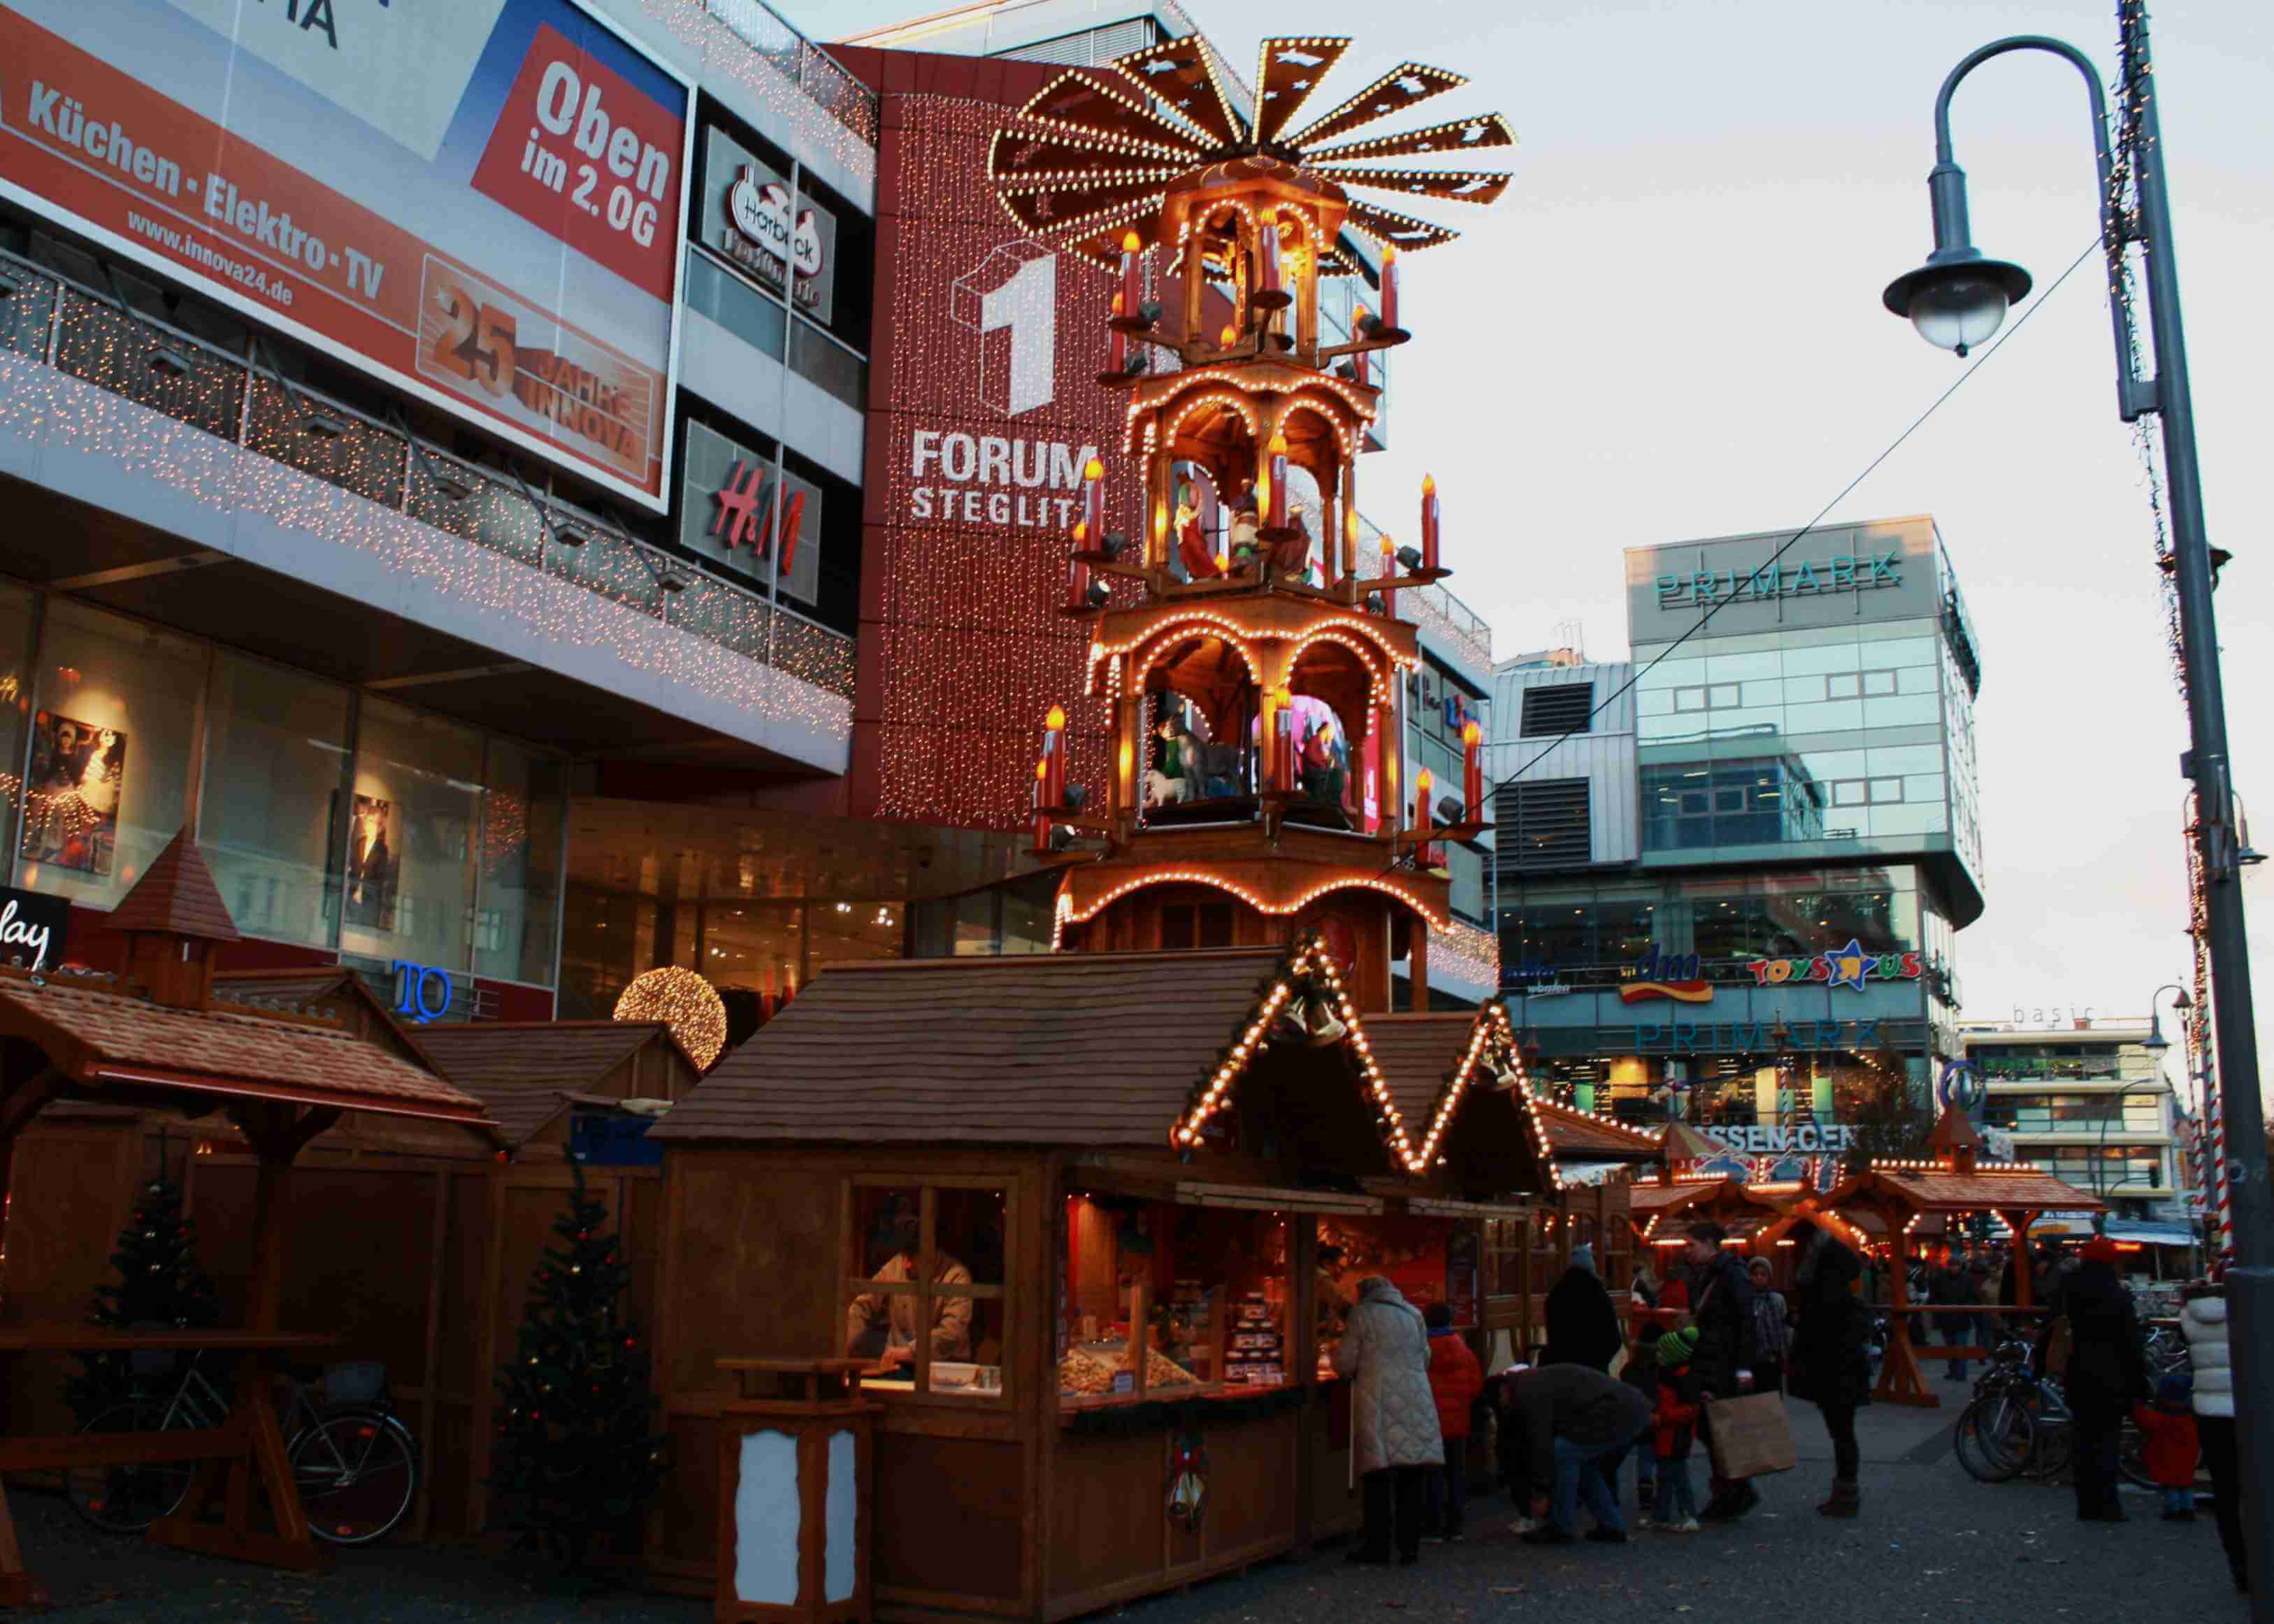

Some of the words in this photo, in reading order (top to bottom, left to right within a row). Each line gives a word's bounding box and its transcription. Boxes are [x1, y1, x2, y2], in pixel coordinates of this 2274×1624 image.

[537, 61, 670, 202] Oben
[29, 79, 180, 198] Küchen
[203, 173, 326, 271] Elektro
[345, 246, 386, 300] TV
[521, 127, 568, 194] im
[570, 164, 599, 217] 2.
[607, 185, 659, 247] OG
[127, 210, 294, 306] www.innova24.de
[433, 284, 517, 398] 25
[526, 380, 638, 461] INNOVA
[912, 429, 1098, 490] FORUM
[715, 459, 805, 577] H&M
[911, 487, 1087, 529] STEGLIT
[1655, 549, 1902, 607] PRIMARK
[1634, 940, 1701, 980] dm
[1746, 956, 1831, 986] TOYS
[1878, 951, 1922, 979] US
